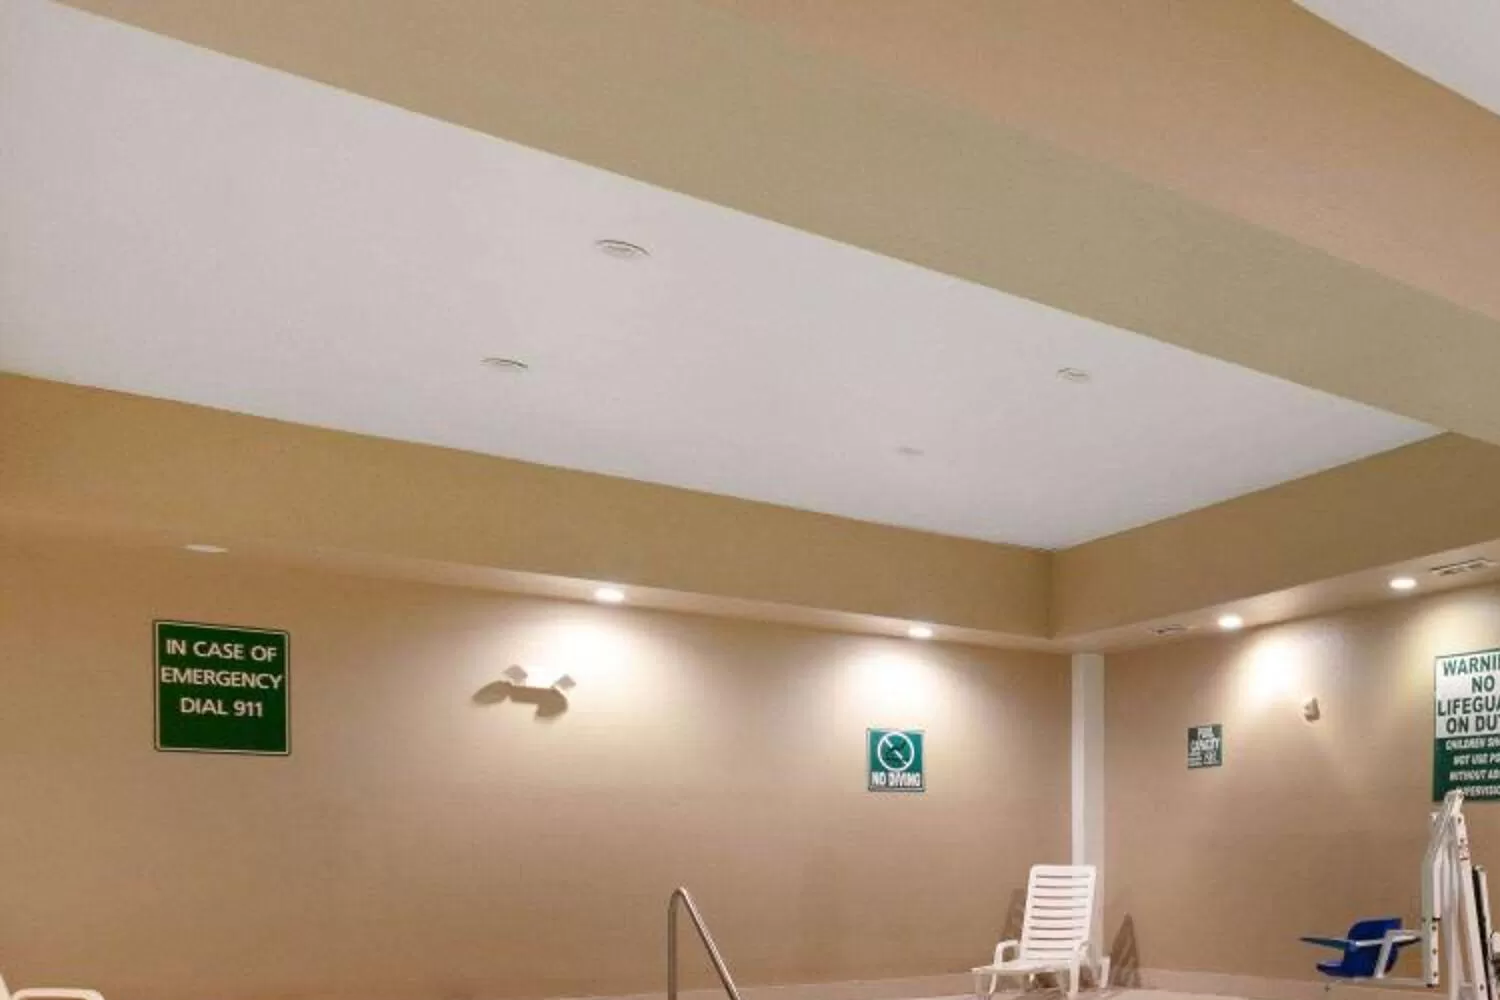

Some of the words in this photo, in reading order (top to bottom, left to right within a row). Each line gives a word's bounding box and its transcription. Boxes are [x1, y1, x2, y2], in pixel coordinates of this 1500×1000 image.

[165, 639, 186, 656] IN
[193, 641, 244, 660] CASE
[251, 645, 277, 662] OF
[161, 666, 282, 689] EMERGENCY
[1472, 675, 1495, 693] NO
[180, 697, 228, 715] DIAL
[233, 700, 263, 717] 911
[1446, 716, 1469, 734] ON
[871, 771, 886, 786] NO
